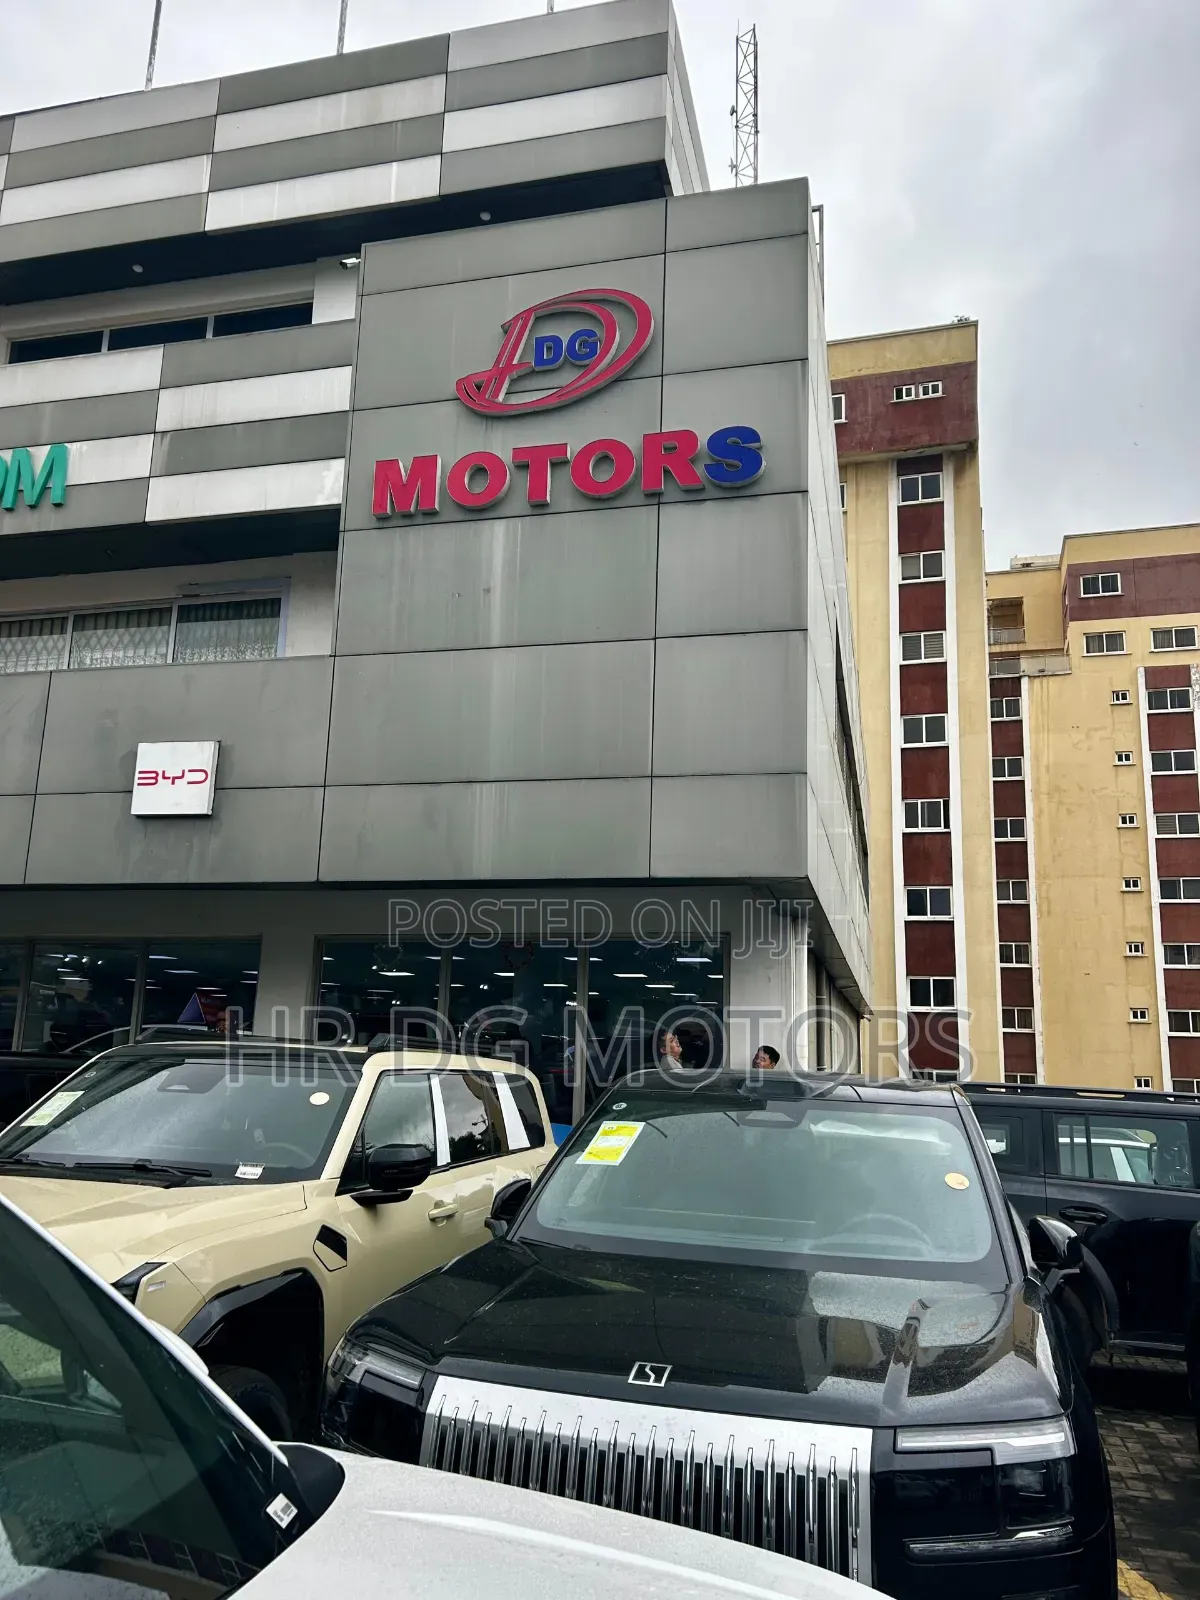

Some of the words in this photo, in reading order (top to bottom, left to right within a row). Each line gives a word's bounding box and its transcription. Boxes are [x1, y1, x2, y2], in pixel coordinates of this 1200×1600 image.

[533, 328, 600, 371] DG
[371, 425, 766, 519] MOTORS
[136, 768, 209, 786] BYD
